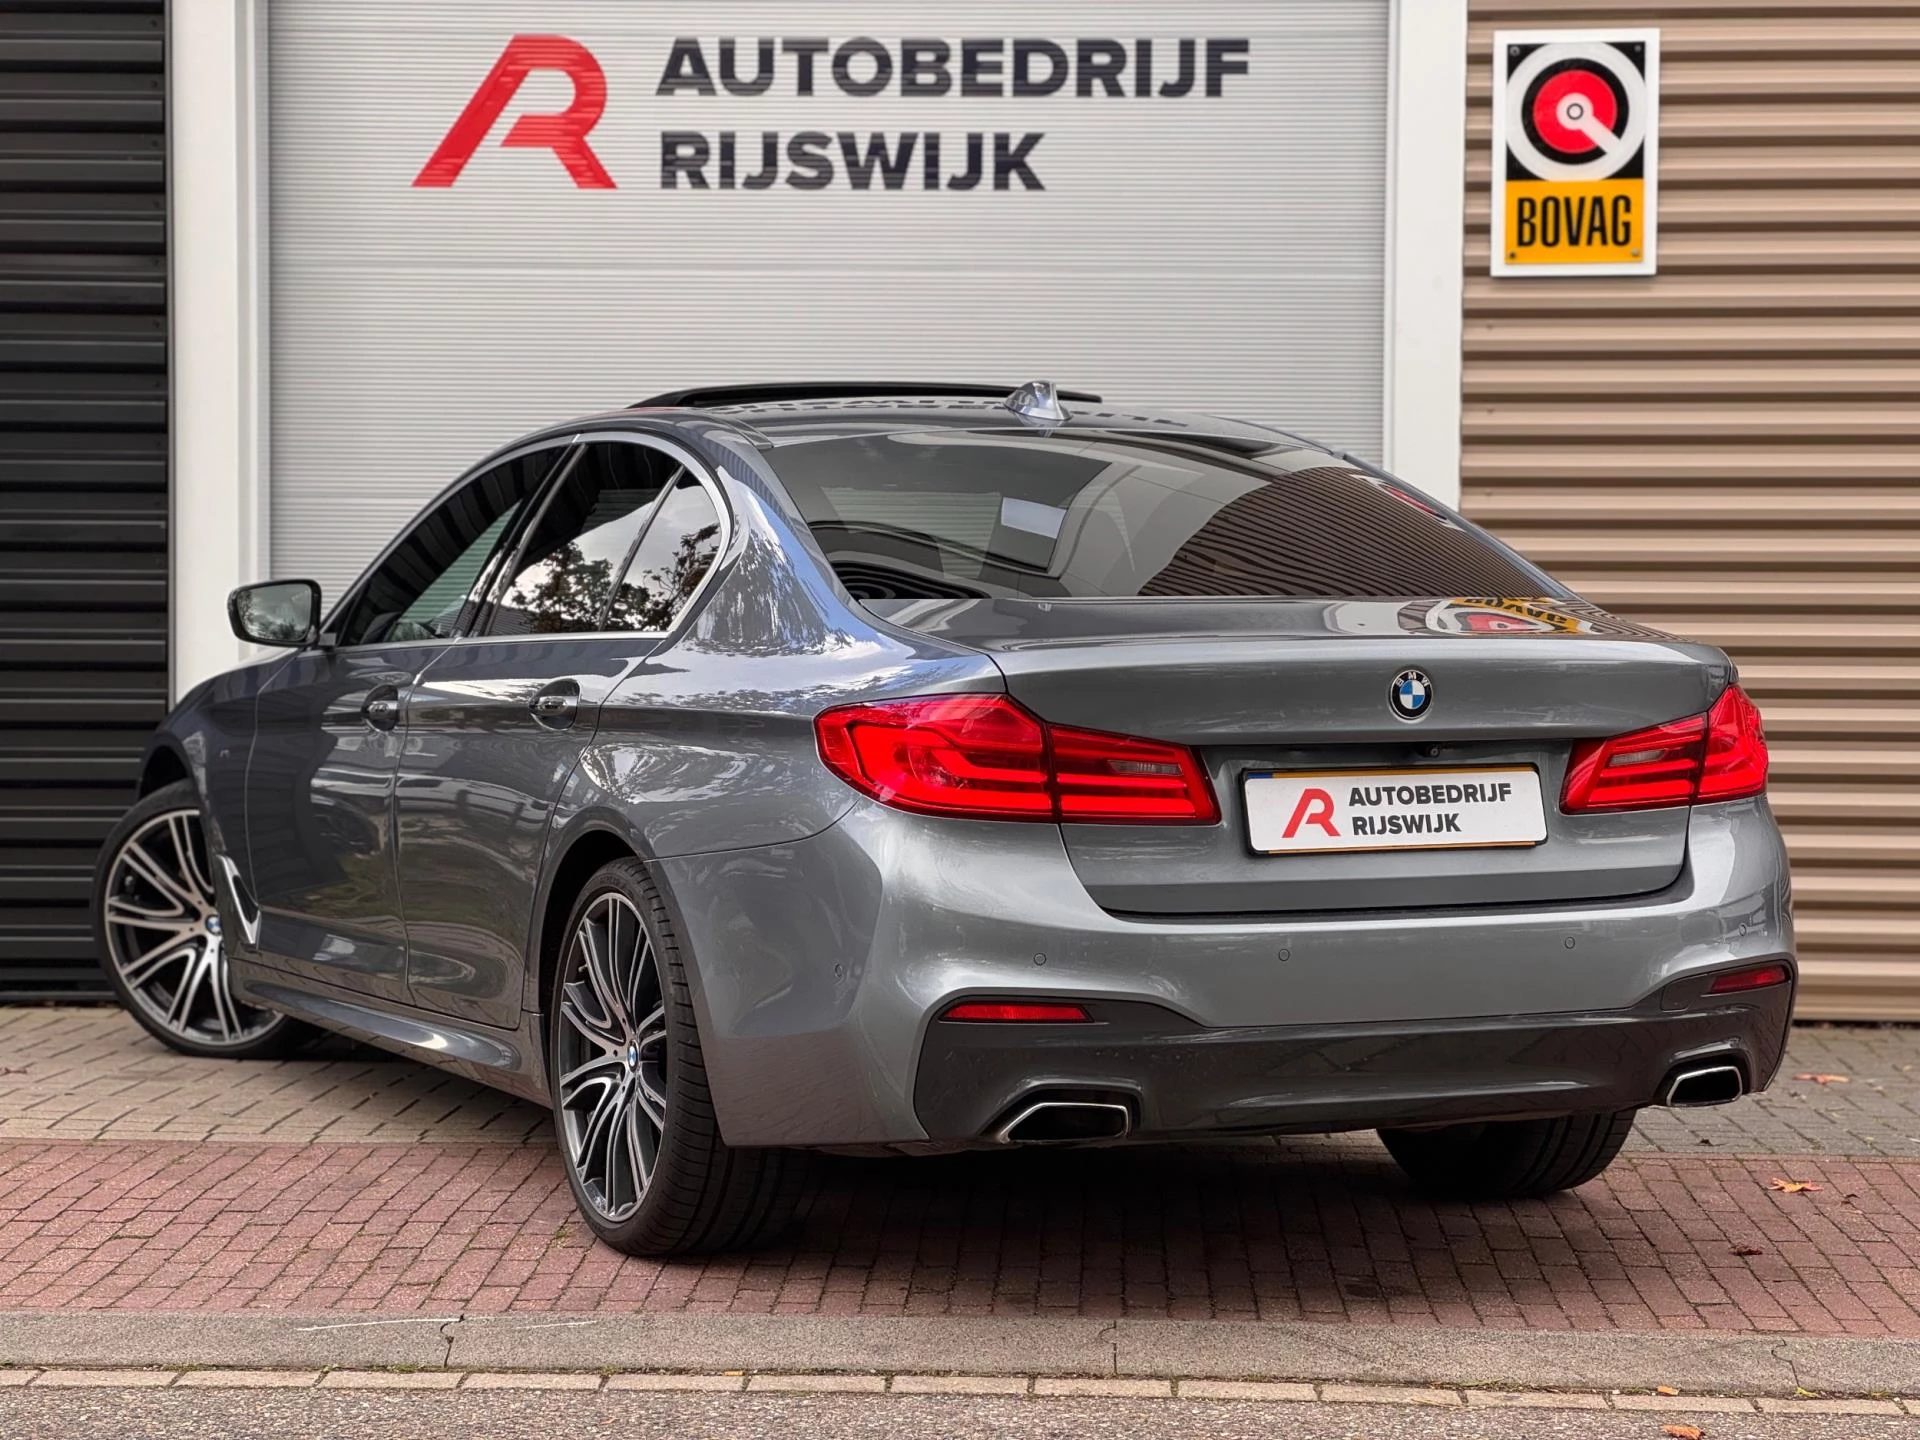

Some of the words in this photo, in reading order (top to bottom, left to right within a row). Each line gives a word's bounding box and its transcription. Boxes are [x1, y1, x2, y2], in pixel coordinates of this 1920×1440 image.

[656, 37, 1250, 98] AUTOBEDRIJF
[660, 131, 1046, 191] RIJSWIJK
[1517, 194, 1632, 248] BOVAG
[1395, 671, 1431, 687] BMW
[1348, 783, 1512, 807] AUTOBEDRIJF
[1352, 813, 1461, 836] RIJSWIJK
